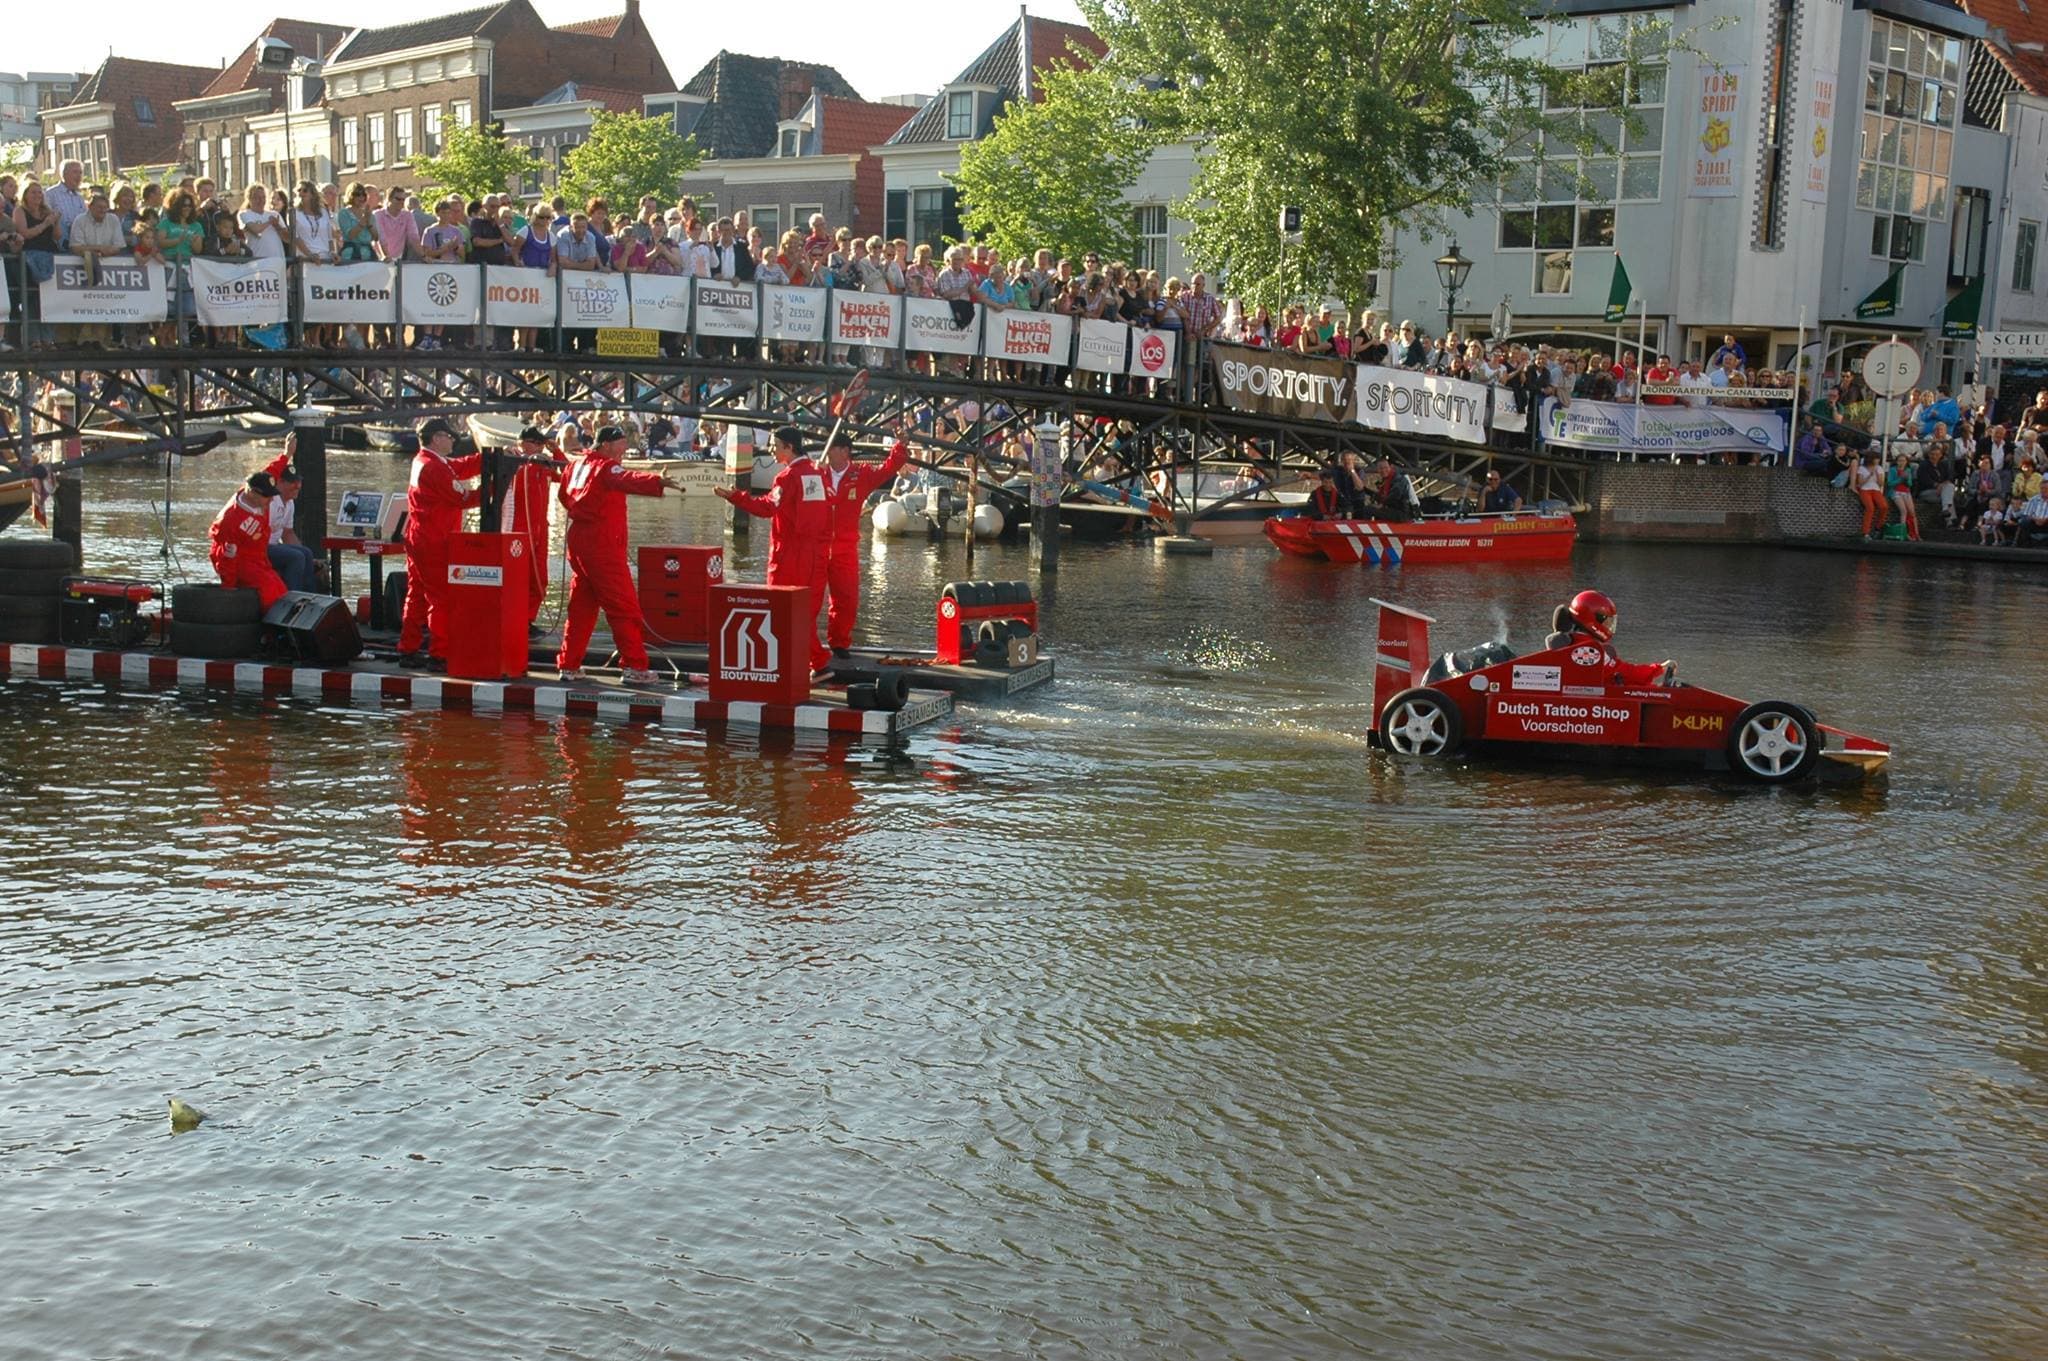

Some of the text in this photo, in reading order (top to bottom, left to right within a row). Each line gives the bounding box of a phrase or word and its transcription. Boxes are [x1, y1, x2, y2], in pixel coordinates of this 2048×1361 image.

[1702, 95, 1736, 112] SPIRIT
[63, 269, 143, 287] SPNTR
[207, 279, 280, 294] van OERLE
[311, 285, 390, 300] Barthen
[83, 292, 127, 300] advocatuur
[488, 286, 539, 304] MOSH
[568, 288, 619, 303] TEDDY
[702, 291, 750, 306] SPLNTR
[788, 294, 805, 304] VAN
[577, 301, 614, 313] KIDS
[841, 301, 879, 312] LEIDSE
[841, 312, 889, 328] LAKEN
[1008, 330, 1051, 344] LAKEN
[1005, 341, 1049, 355] FEESTEN
[1084, 341, 1121, 353] CITY HALL
[1141, 346, 1163, 360] LOS
[1223, 359, 1347, 406] SPORTCITY.
[1645, 386, 1713, 395] RONDVAARTEN
[1726, 388, 1758, 396] CANAL
[1367, 382, 1478, 426] SPORTCITY.
[1590, 426, 1620, 436] SERVICES
[1675, 426, 1735, 440] zorgeloos
[1631, 436, 1673, 446] schoon
[1493, 519, 1536, 533] pioner
[1404, 539, 1447, 547] BRANDWEER
[1017, 643, 1028, 662] 3
[720, 671, 780, 682] HOUTWERF
[897, 696, 951, 729] DE STAMGASTEN
[1497, 701, 1629, 721] Dutch Tattoo Shop
[1521, 718, 1604, 734] Voorschoten
[1673, 714, 1723, 731] DELPHI
